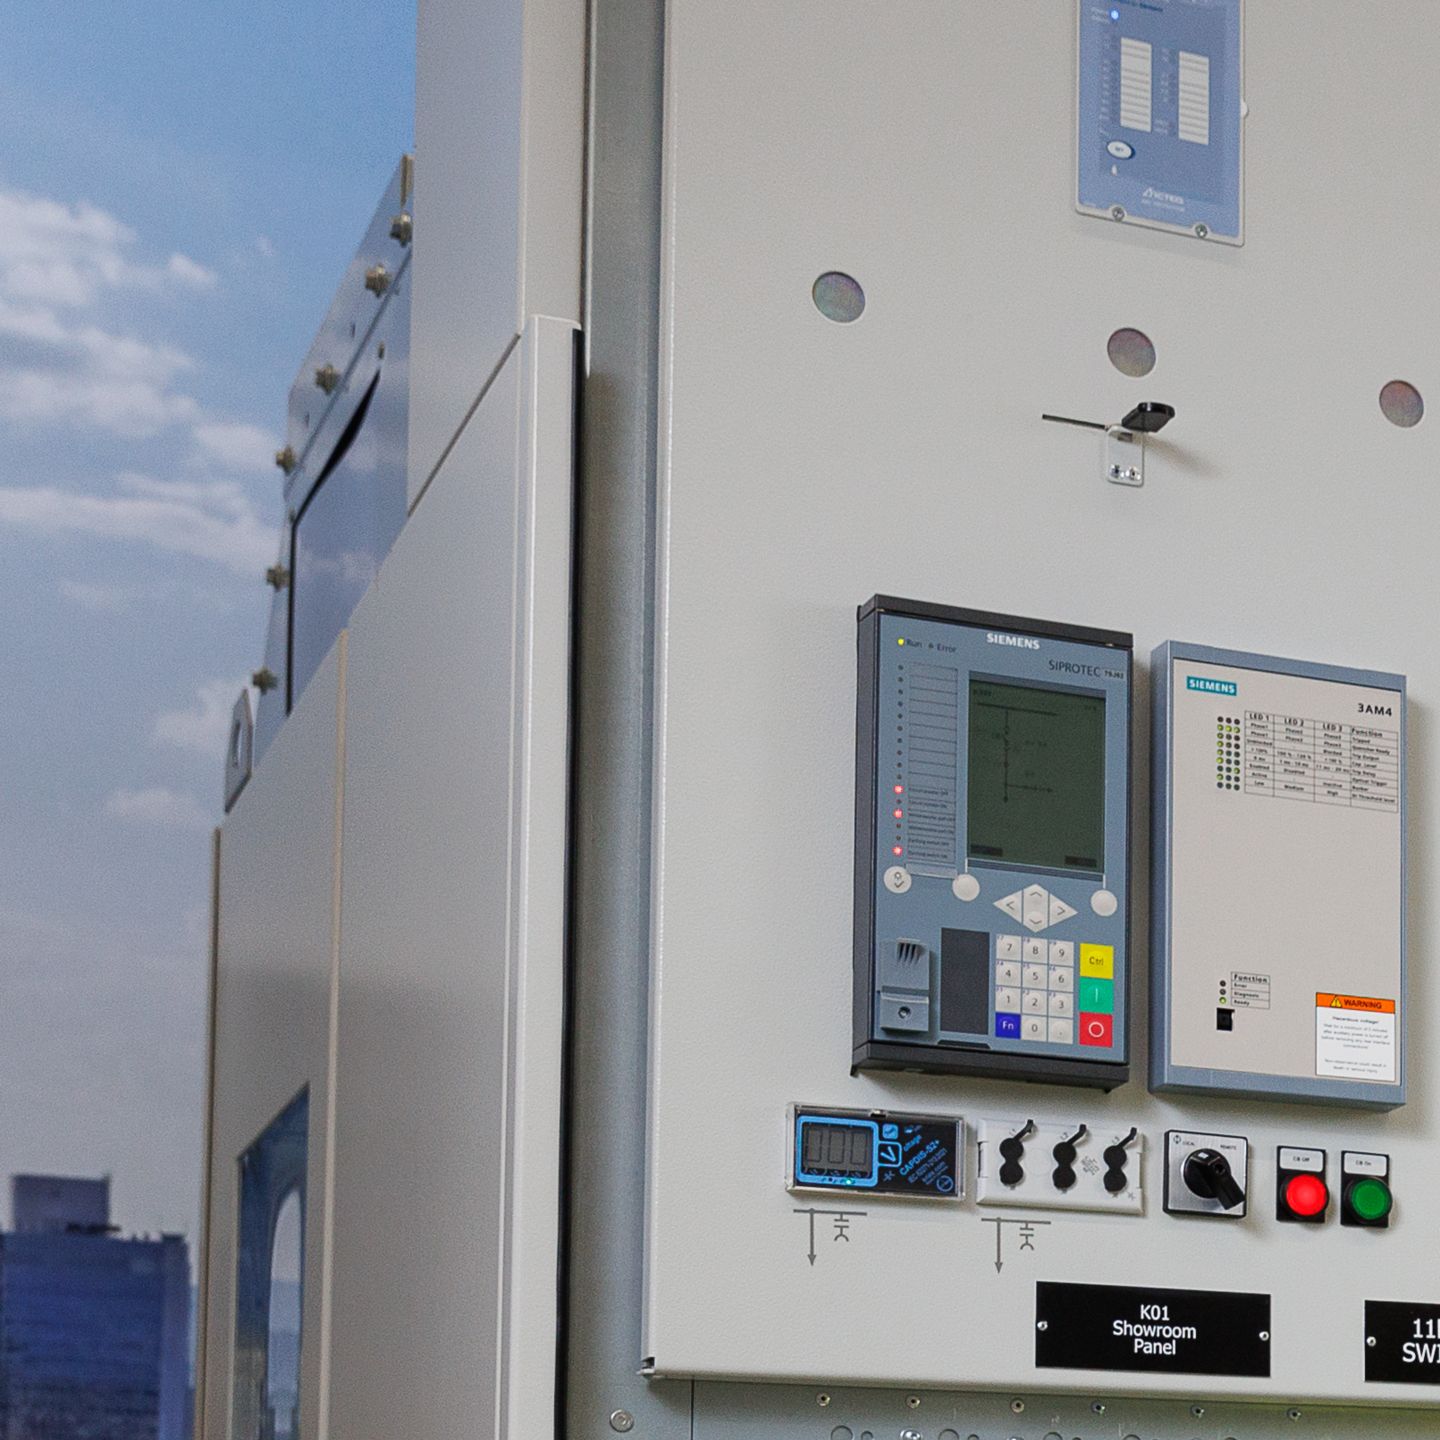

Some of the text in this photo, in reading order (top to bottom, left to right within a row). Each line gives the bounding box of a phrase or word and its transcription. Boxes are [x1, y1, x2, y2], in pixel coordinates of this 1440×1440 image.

[906, 639, 923, 649] Run
[986, 631, 1041, 650] SIEMENS
[937, 642, 957, 653] Error
[1048, 658, 1101, 677] SIPROTEC
[1188, 677, 1237, 695] SIEMENS
[1358, 702, 1392, 717] 3AM4
[1249, 713, 1265, 721] LED
[1284, 718, 1299, 726] LED
[1322, 723, 1337, 731] LED
[1351, 727, 1383, 738] Function
[1007, 943, 1013, 952] 7
[1032, 946, 1039, 955] 8
[1058, 948, 1065, 957] 9
[1089, 956, 1104, 966] Ctrl
[1005, 969, 1011, 977] 4
[1032, 972, 1039, 980] 5
[1233, 973, 1268, 983] Function
[1058, 975, 1065, 983] 6
[1006, 995, 1010, 1004] 1
[1032, 998, 1038, 1007] 2
[1059, 1000, 1064, 1009] 3
[1344, 998, 1382, 1009] WARNING
[1002, 1020, 1014, 1030] Fn
[1031, 1024, 1038, 1032] 0
[1138, 1303, 1171, 1322] K01
[1111, 1321, 1198, 1341] Showroom
[1133, 1337, 1178, 1357] Panel
